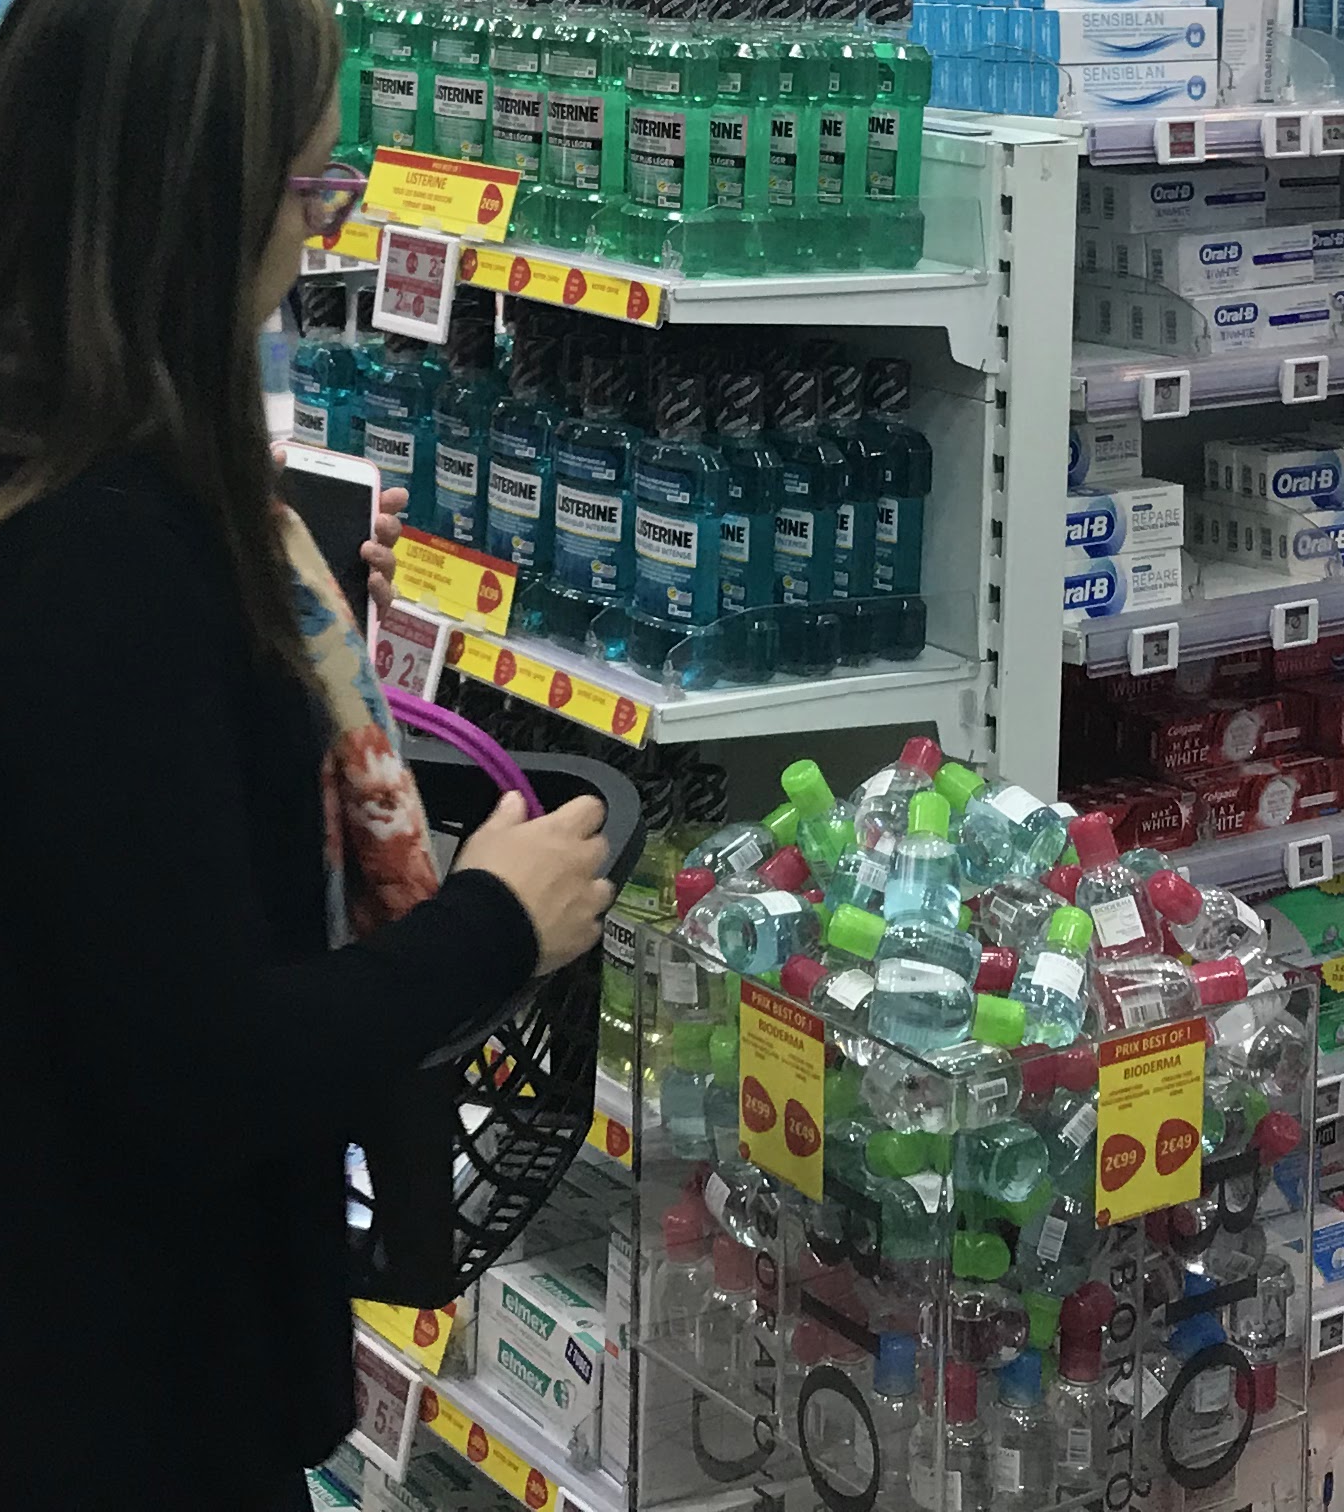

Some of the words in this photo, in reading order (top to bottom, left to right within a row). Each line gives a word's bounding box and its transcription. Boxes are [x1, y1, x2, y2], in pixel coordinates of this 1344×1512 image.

[1082, 12, 1165, 28] SENSIBLAN
[1082, 66, 1165, 81] SENSIBLAN
[406, 171, 448, 190] LISTERINE
[1153, 183, 1191, 201] Oral-B
[1203, 244, 1239, 262] Oral-B
[1216, 305, 1256, 324] Oral-B
[1277, 468, 1334, 494] Oral-B
[558, 494, 618, 524] LISTERINE
[637, 516, 693, 550] LISTERINE
[1066, 515, 1108, 541] ral-B
[406, 544, 447, 569] LISTERINE
[1064, 577, 1108, 604] ral-B
[1165, 747, 1208, 768] WHITE
[1142, 816, 1180, 832] WHITE
[752, 991, 771, 1012] PRIX
[773, 1003, 793, 1021] BEST
[759, 1018, 805, 1052] BIODERMA
[1115, 1041, 1140, 1058] PRIX
[1142, 1034, 1168, 1052] BEST
[1170, 1028, 1185, 1043] OF
[1124, 1055, 1182, 1080] BIODERMA
[745, 1094, 770, 1118] 2€99
[1161, 1134, 1192, 1155] 2€49
[1105, 1149, 1137, 1172] 2€99
[505, 1287, 552, 1340] elmex
[500, 1346, 547, 1397] elmex
